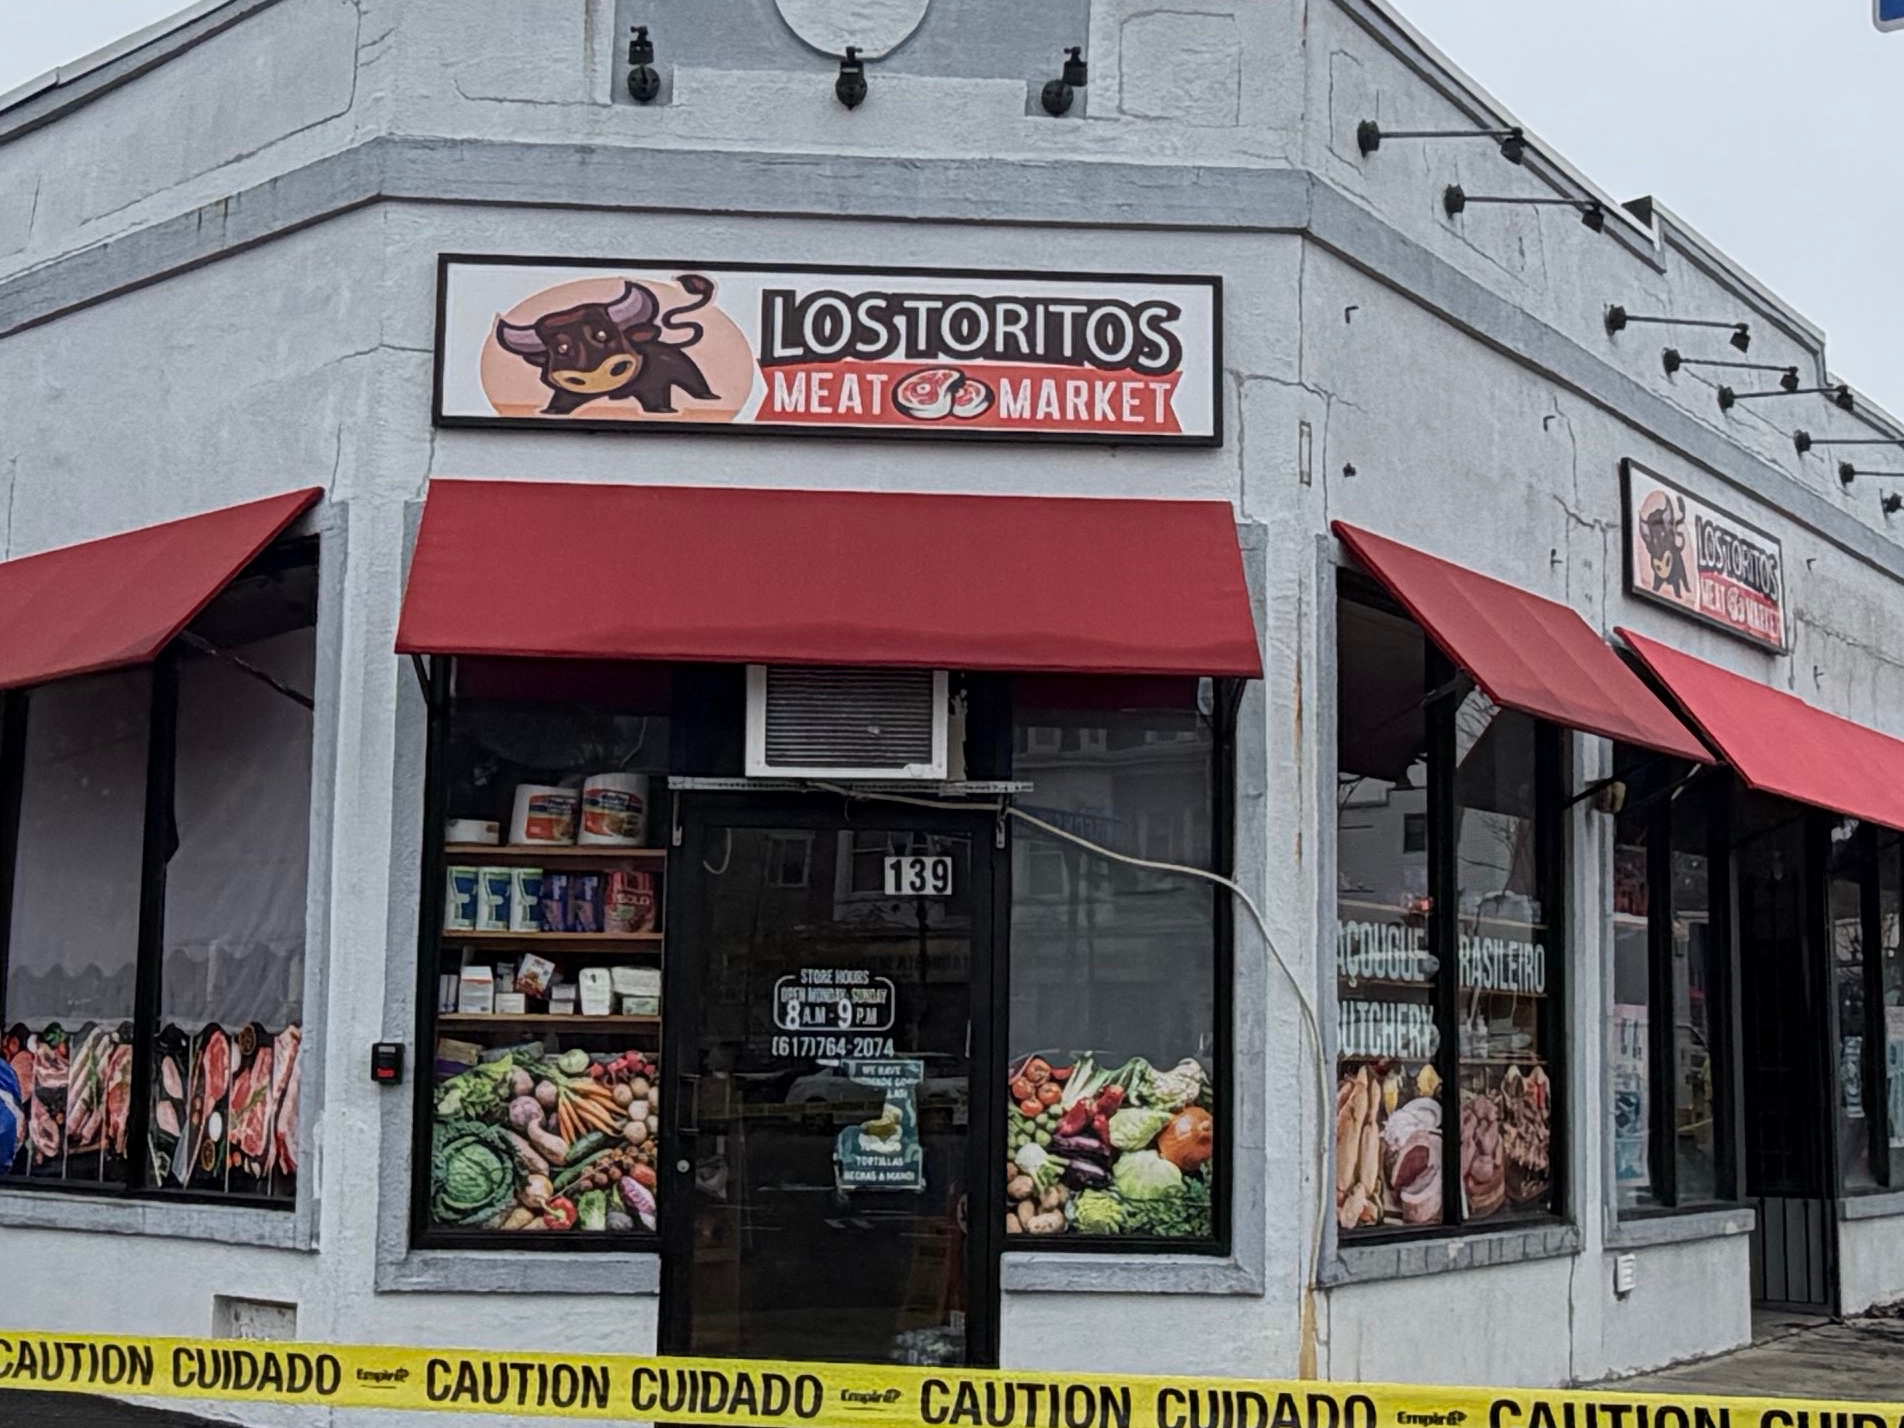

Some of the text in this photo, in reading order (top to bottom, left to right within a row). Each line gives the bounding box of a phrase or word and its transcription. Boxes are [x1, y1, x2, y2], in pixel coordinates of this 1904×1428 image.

[773, 371, 1172, 425] MEAT MARKET
[889, 858, 949, 894] 139
[800, 968, 870, 985] STORE HOURS
[1458, 934, 1546, 994] RASILEIRO
[171, 1346, 341, 1396] CUIDADO
[425, 1357, 610, 1409] CAUTION
[631, 1366, 824, 1419] CUIDADO
